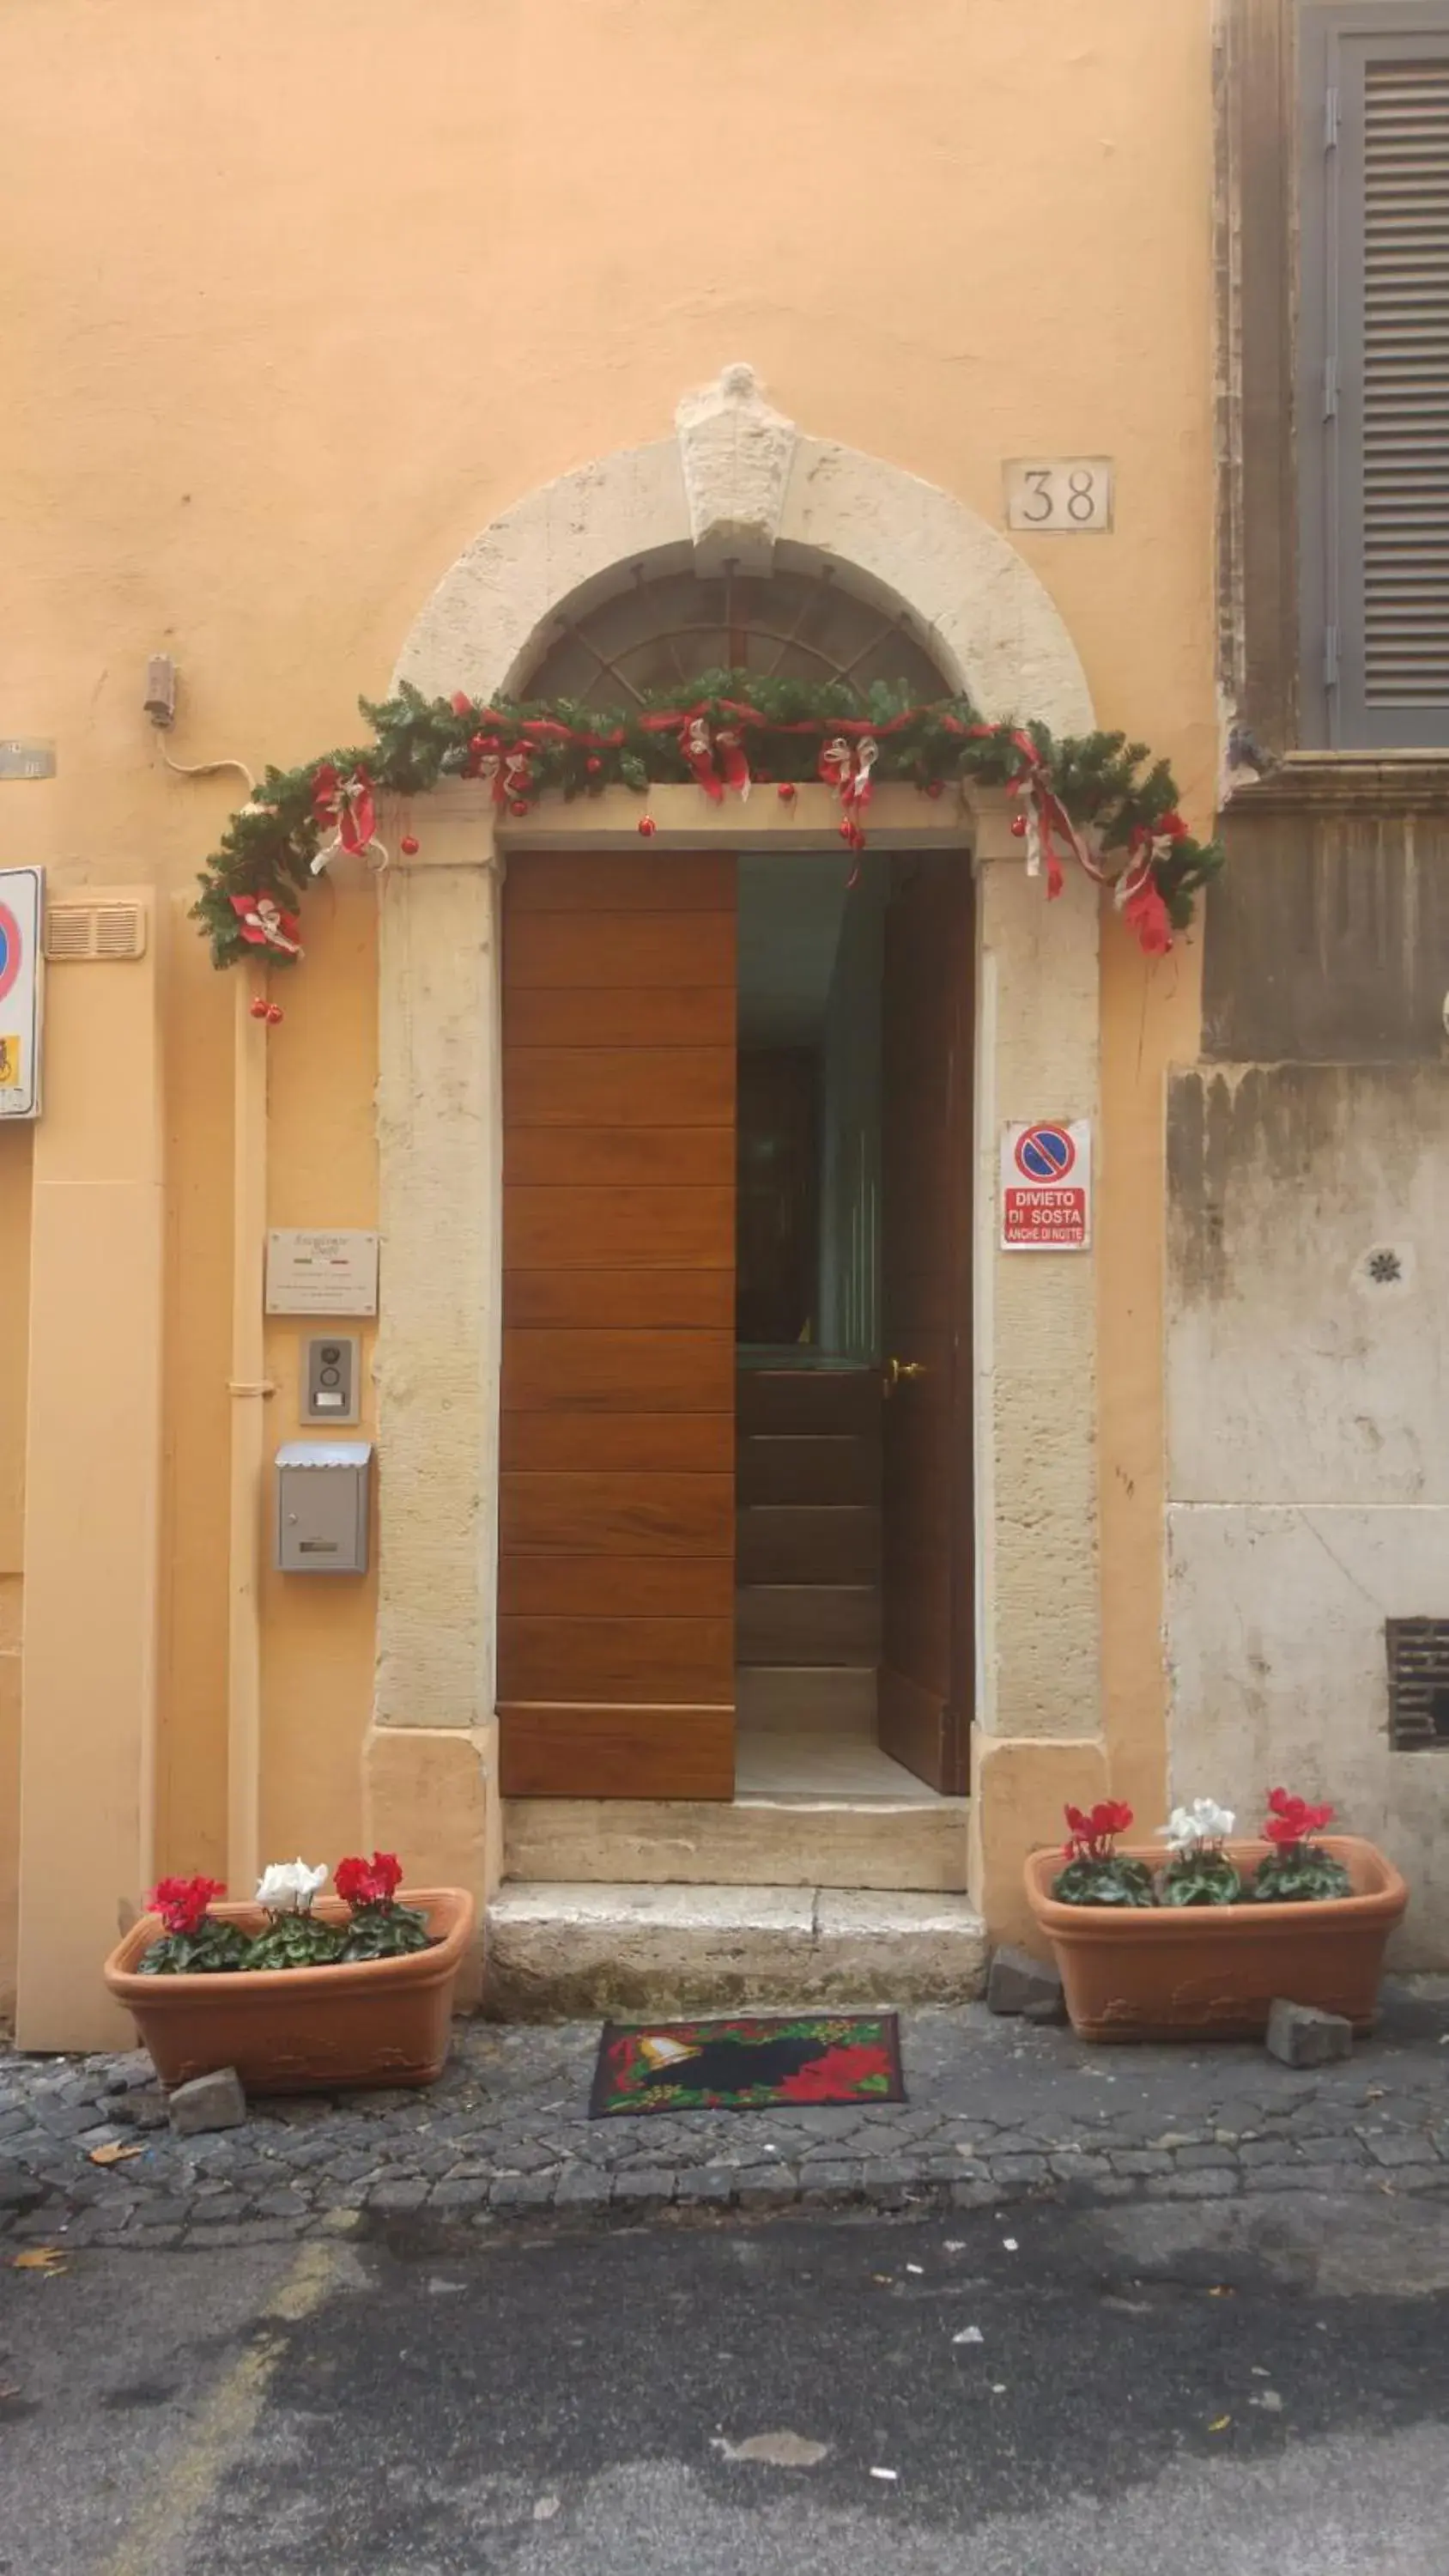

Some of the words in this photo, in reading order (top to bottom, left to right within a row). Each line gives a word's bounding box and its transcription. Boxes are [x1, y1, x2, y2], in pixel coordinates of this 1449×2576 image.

[1022, 469, 1094, 522] 38
[1016, 1191, 1075, 1206] DIVIETO
[1009, 1209, 1024, 1224] DI
[1031, 1209, 1082, 1224] SOSTA
[1008, 1227, 1040, 1240] ANCHE
[1041, 1227, 1051, 1240] DI
[1052, 1227, 1083, 1240] NOTTE
